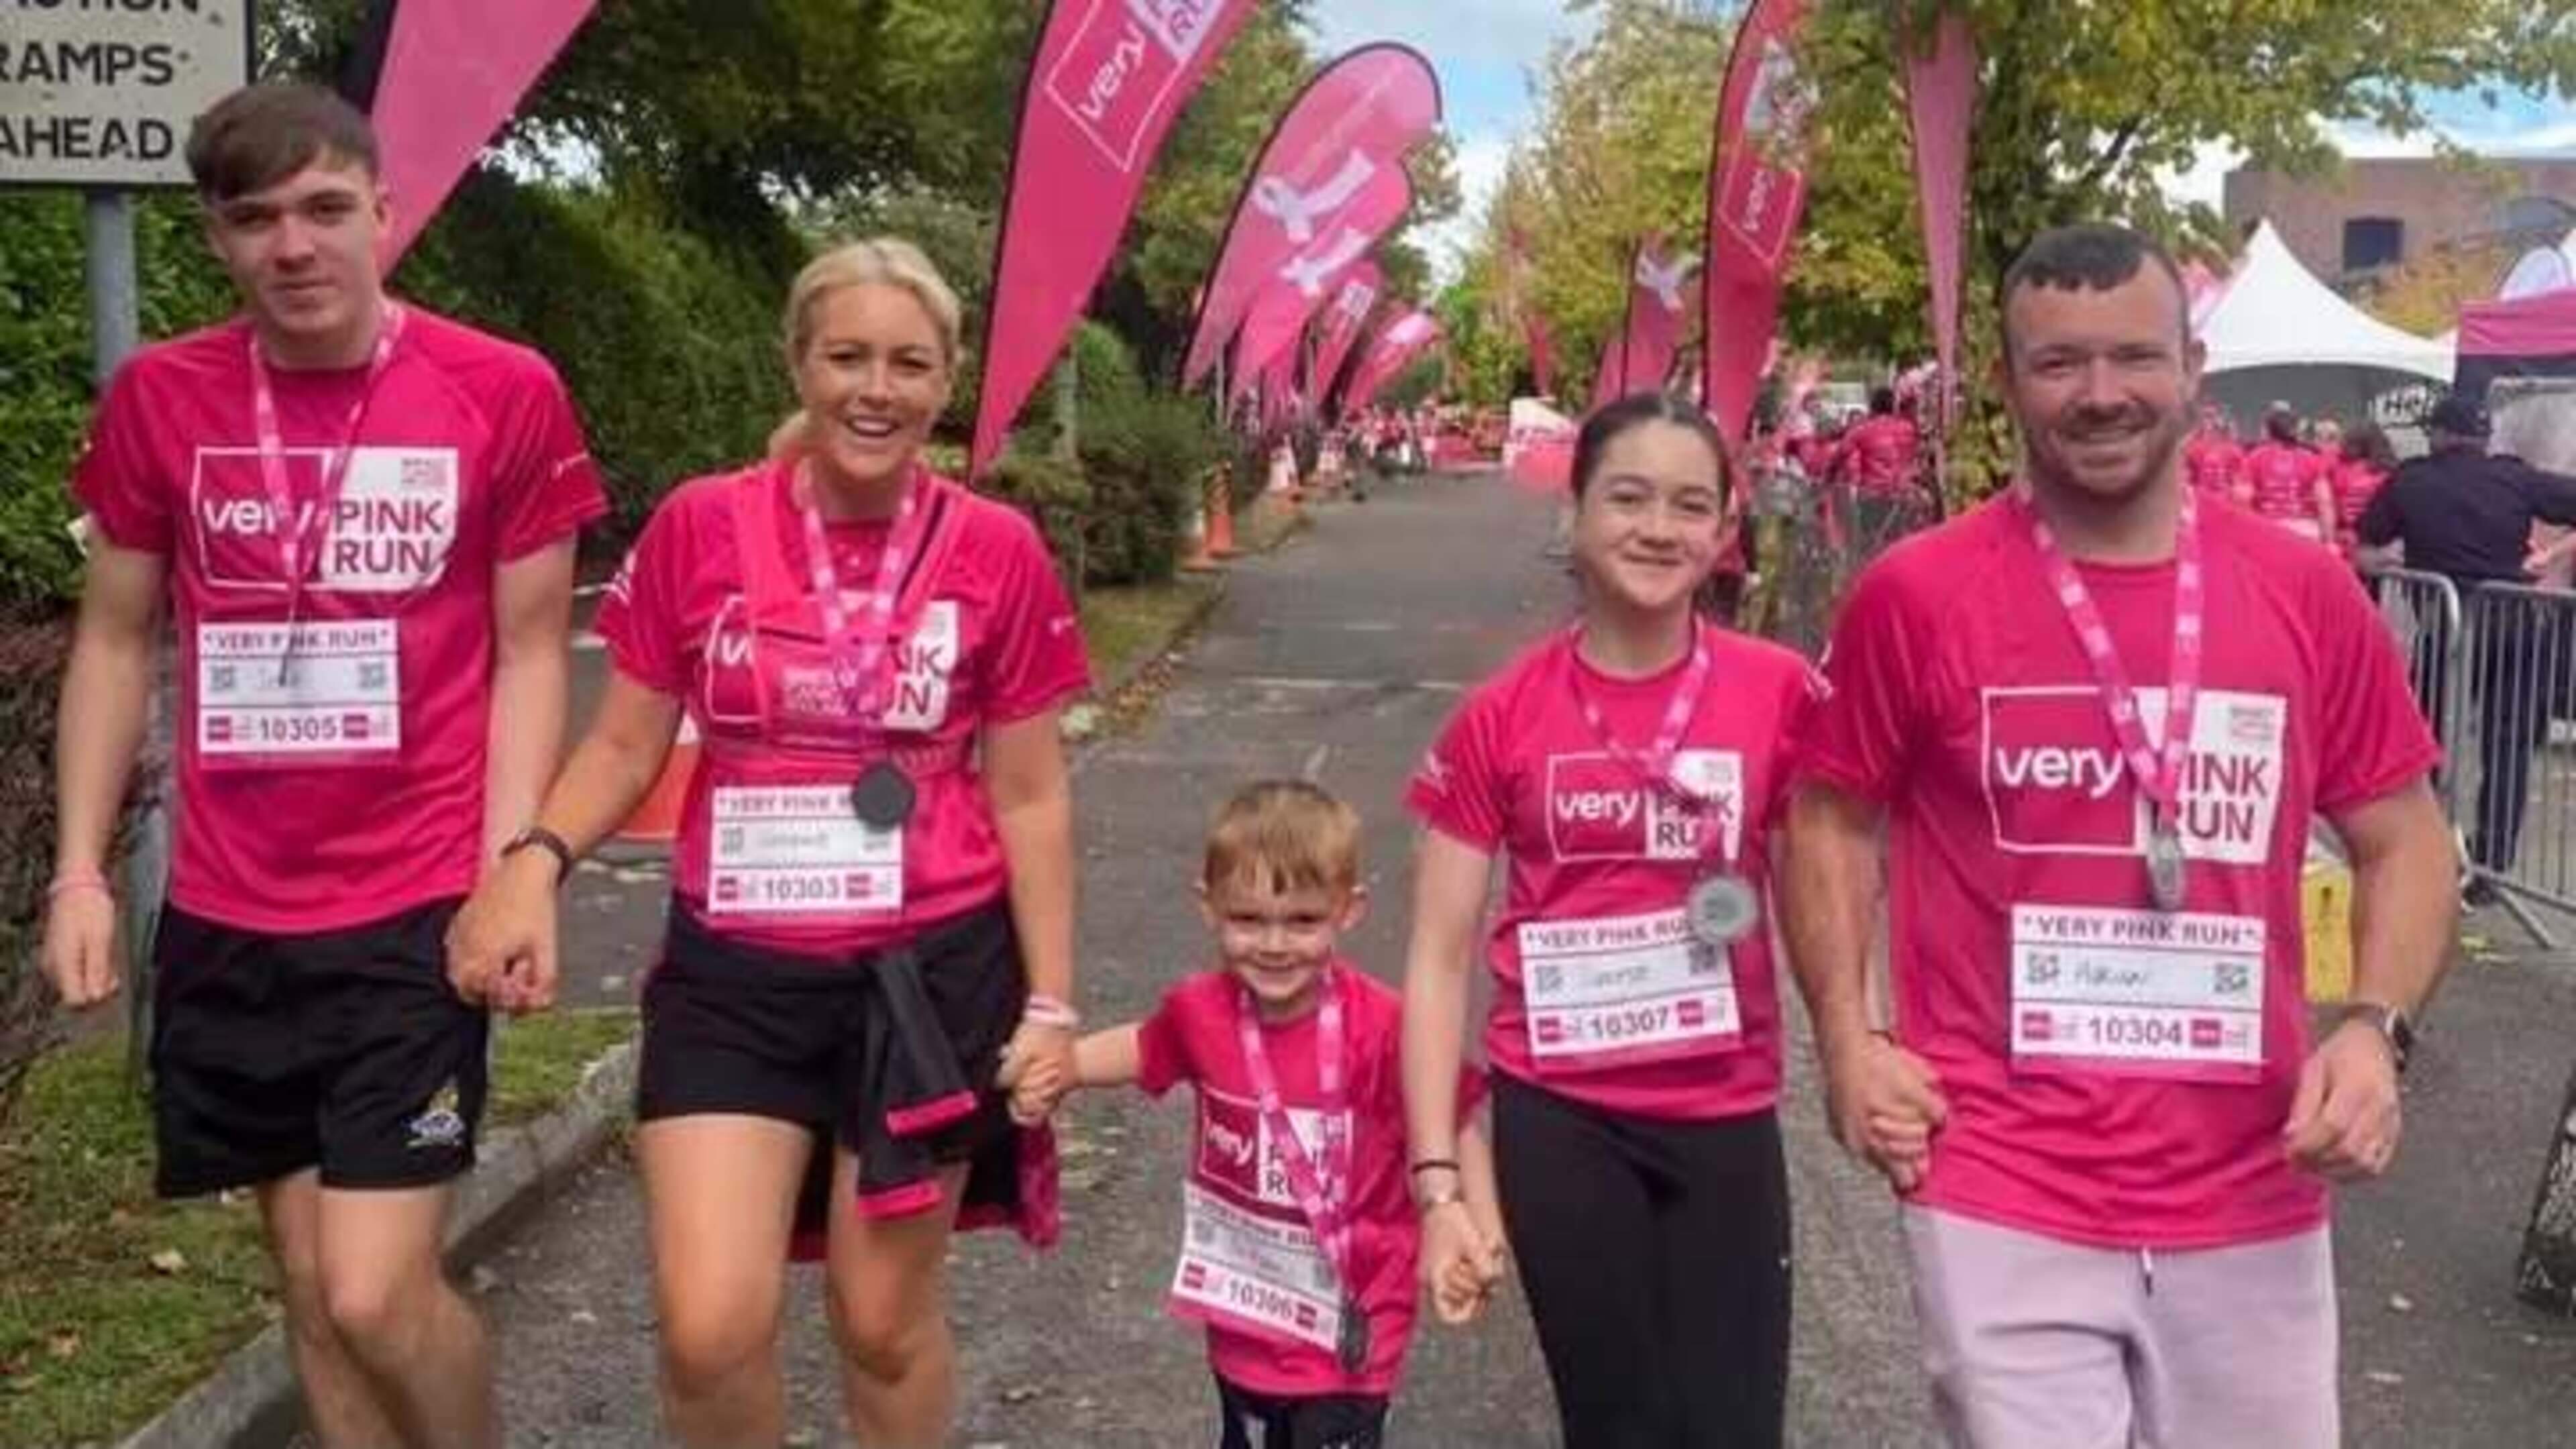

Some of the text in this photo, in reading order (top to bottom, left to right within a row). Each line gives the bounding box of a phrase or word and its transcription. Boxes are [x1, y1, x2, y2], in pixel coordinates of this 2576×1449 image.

[0, 117, 173, 160] AHEAD
[337, 500, 443, 534] PINK
[335, 539, 432, 574] RUN
[219, 629, 264, 649] VERY
[260, 715, 337, 741] 10305
[1995, 745, 2269, 800] very INK
[1555, 789, 1640, 830] very
[2037, 915, 2241, 945] VERY PINK RUN
[1589, 1006, 1669, 1038] 10307
[2088, 1016, 2182, 1045] 10304
